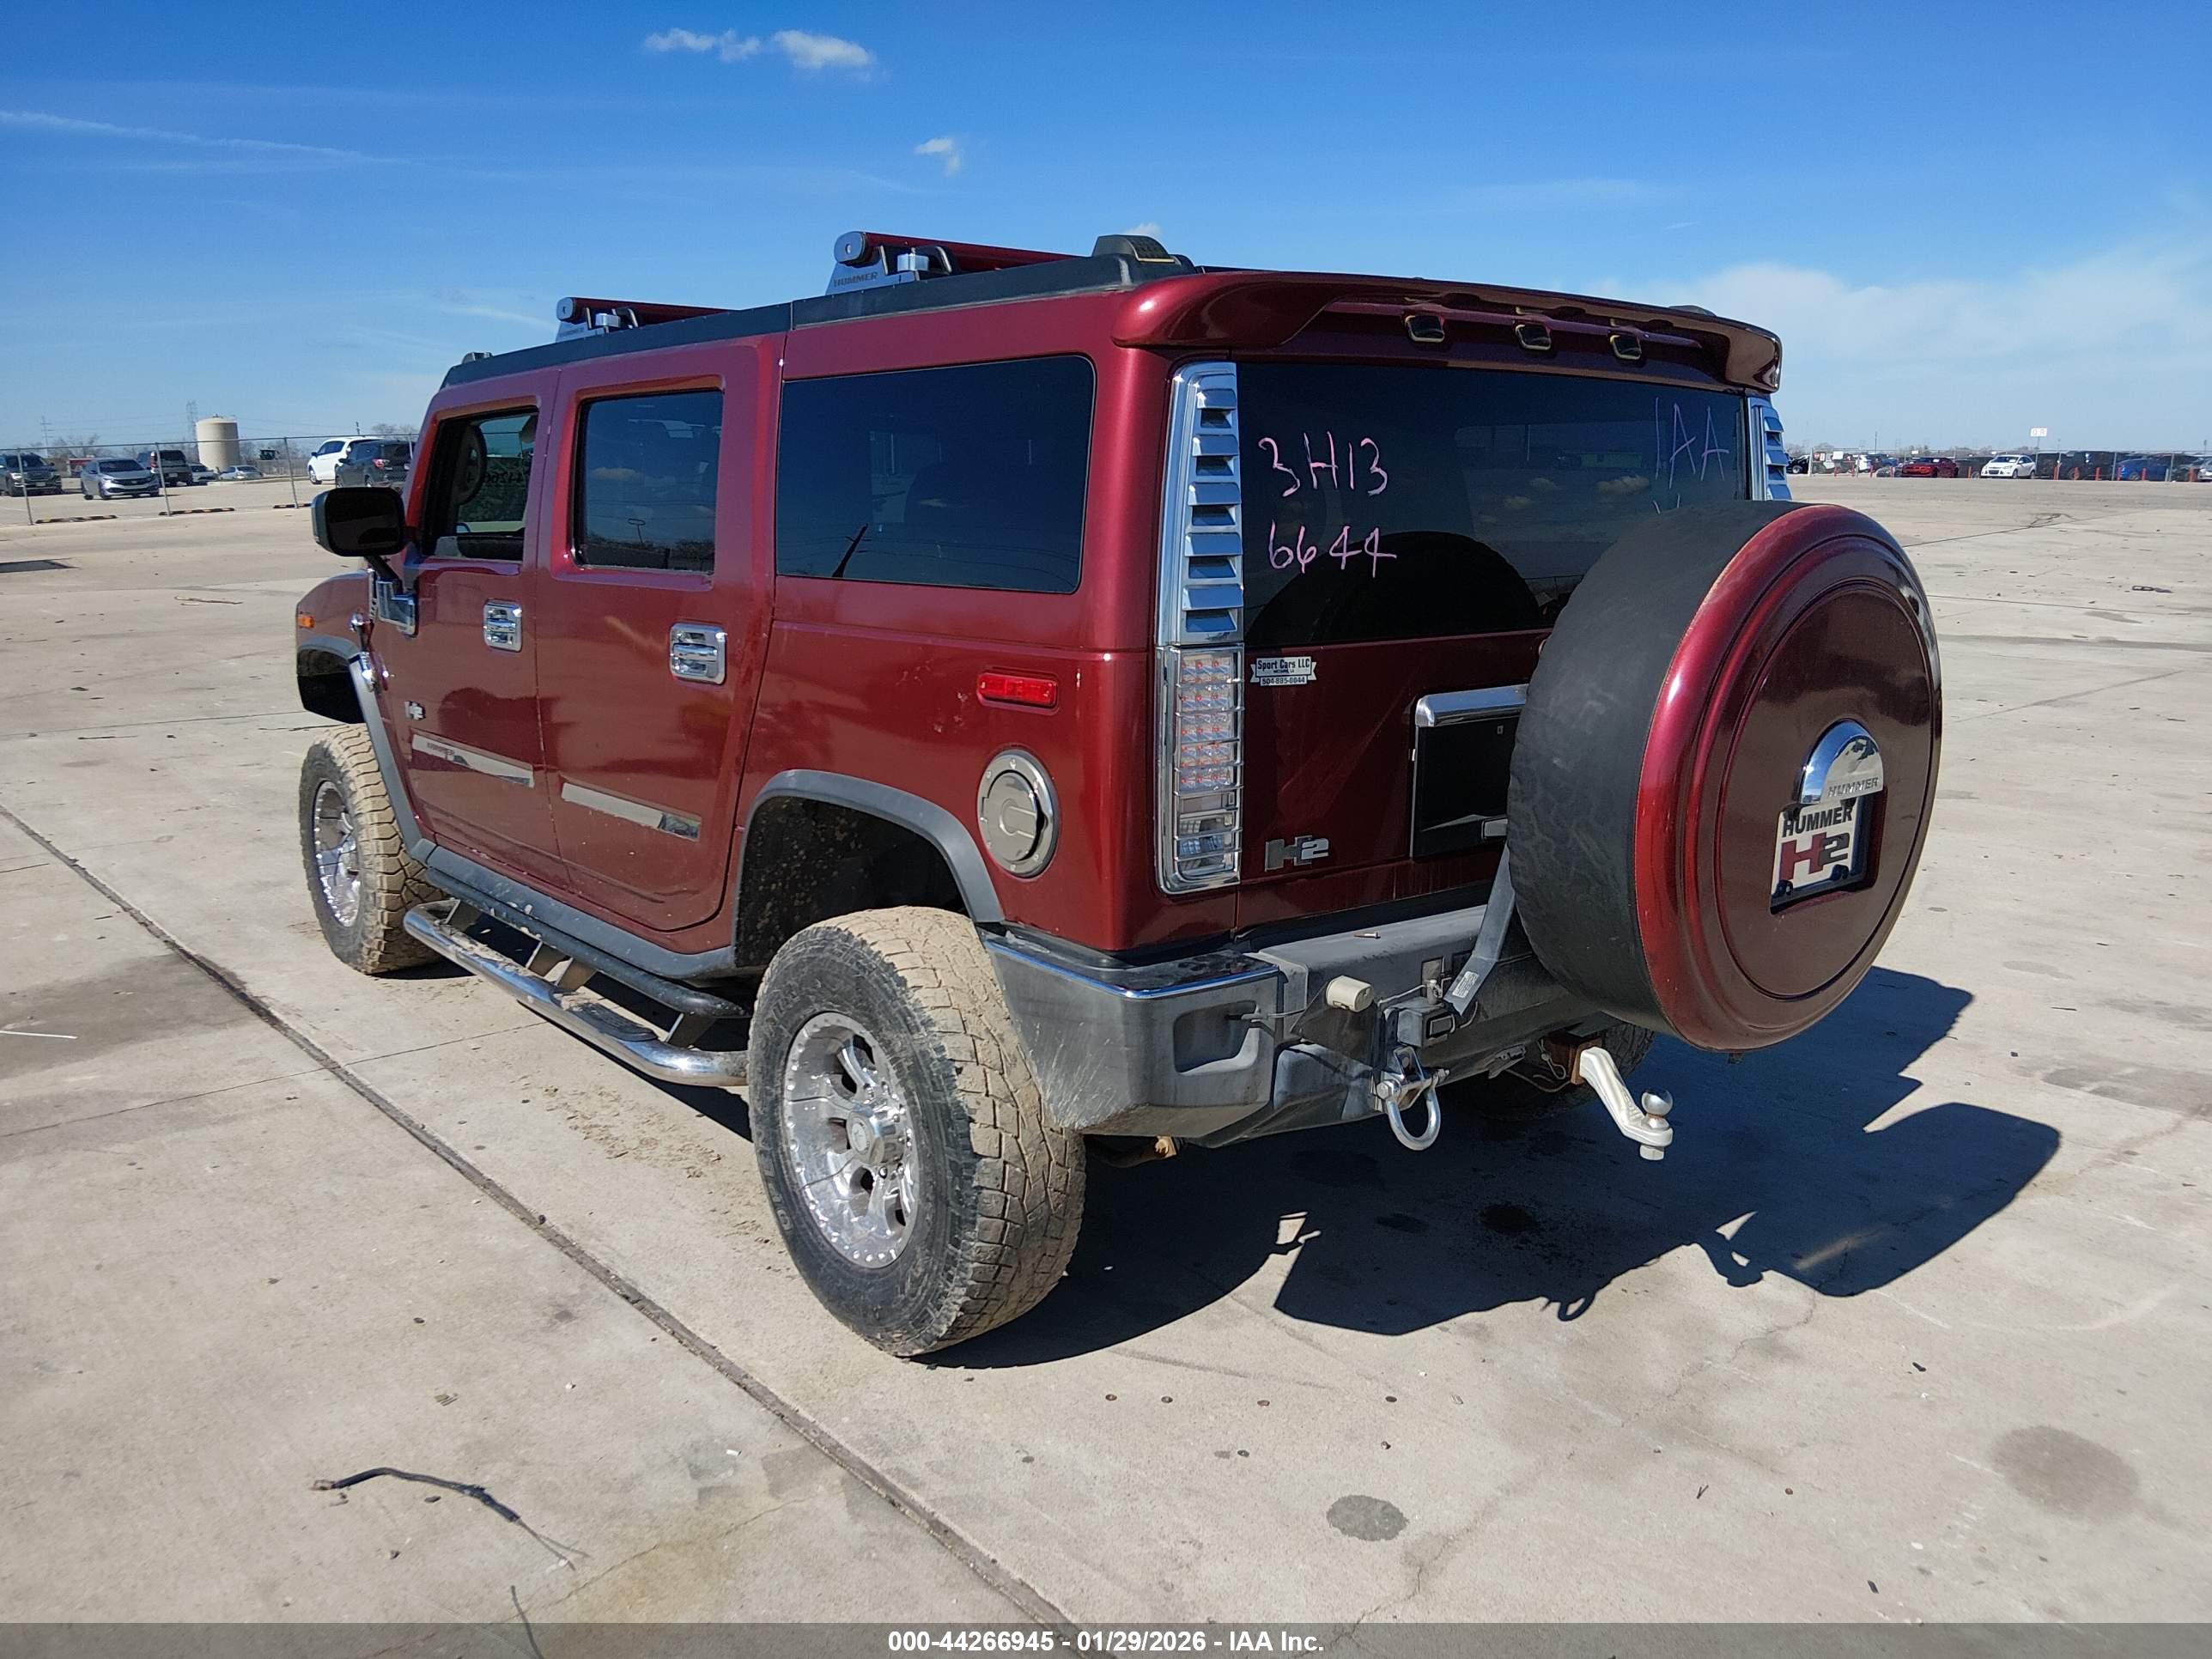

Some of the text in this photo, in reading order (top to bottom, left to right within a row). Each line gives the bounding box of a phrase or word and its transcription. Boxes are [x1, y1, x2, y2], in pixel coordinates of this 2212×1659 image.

[1258, 431, 1388, 497] 3H13
[1654, 397, 1729, 489] IAA
[1268, 519, 1397, 577] 6644
[1257, 659, 1278, 672] Sport
[1279, 659, 1296, 669] Cars
[1297, 658, 1310, 668] LLC
[1828, 777, 1879, 798] HUMMER
[1782, 805, 1853, 838] HUMMER
[1264, 835, 1329, 872] H2
[1778, 831, 1850, 881] H2
